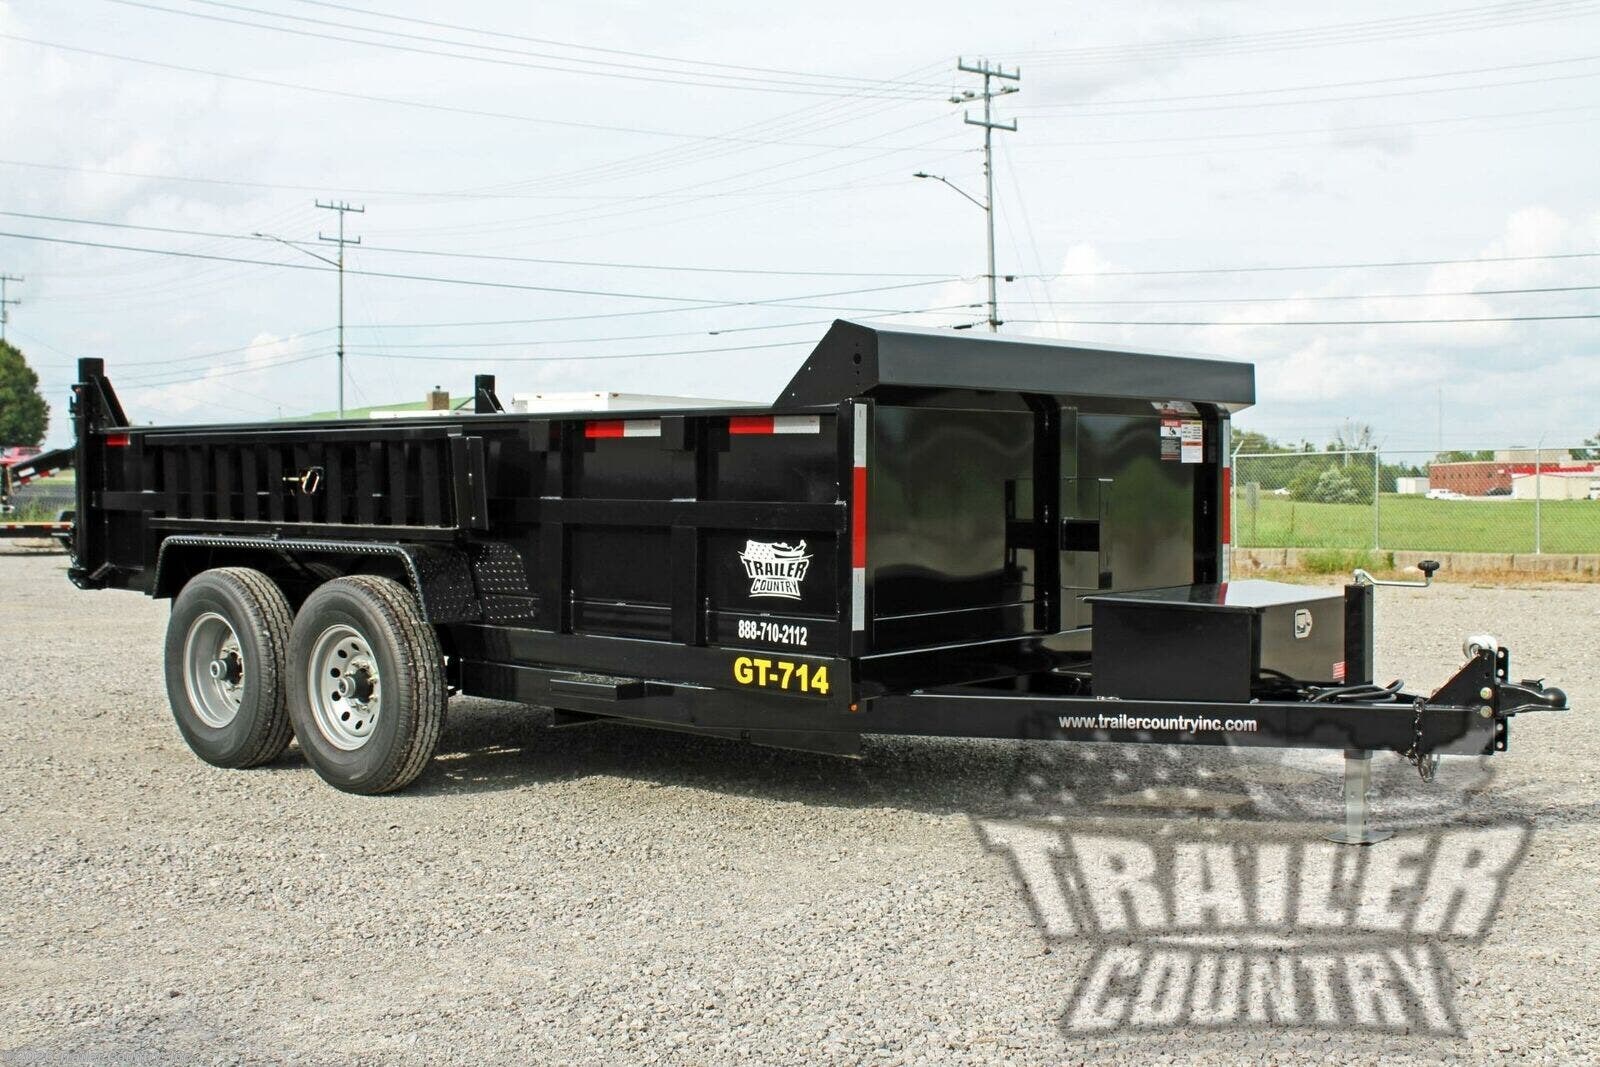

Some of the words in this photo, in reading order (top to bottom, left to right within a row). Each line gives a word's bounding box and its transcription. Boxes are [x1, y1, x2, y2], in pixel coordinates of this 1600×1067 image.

[743, 559, 806, 579] TRAILER
[752, 578, 799, 594] COUNTRY
[738, 619, 808, 646] 888-710-2112
[734, 656, 829, 694] GT-714
[1058, 713, 1258, 734] www.trailercountryinc.com
